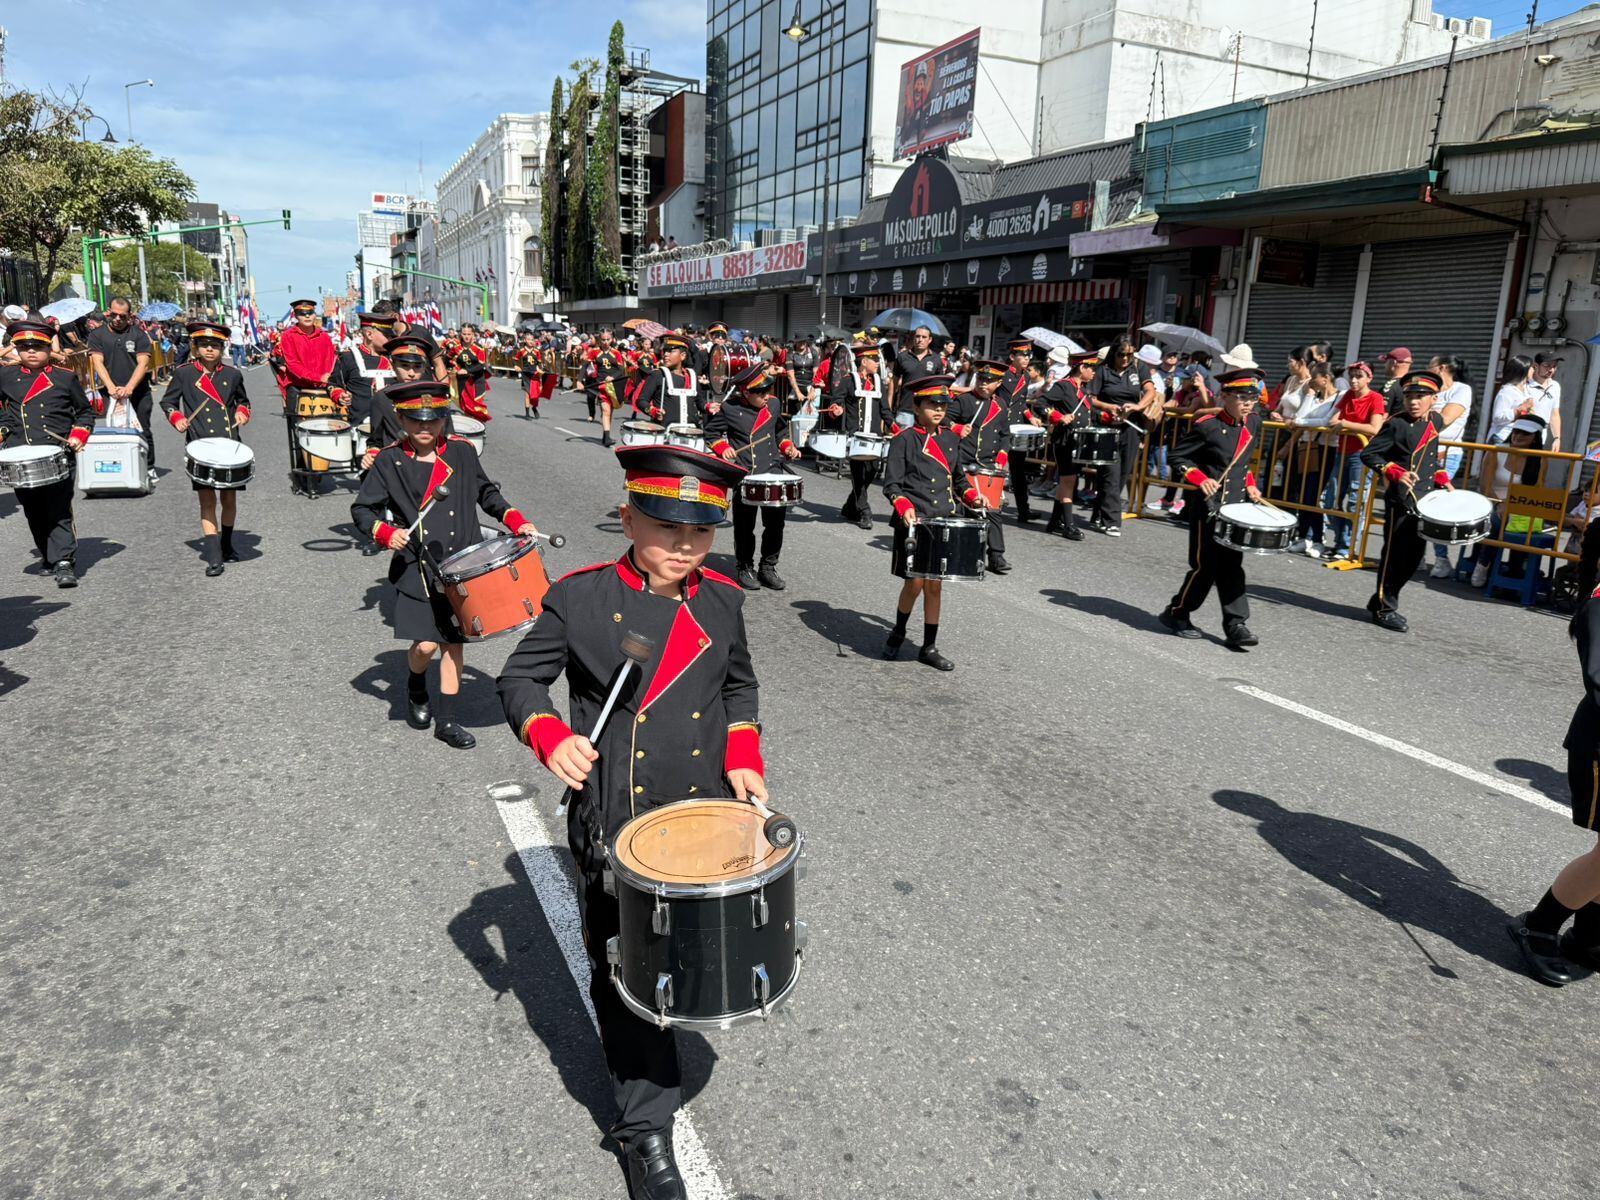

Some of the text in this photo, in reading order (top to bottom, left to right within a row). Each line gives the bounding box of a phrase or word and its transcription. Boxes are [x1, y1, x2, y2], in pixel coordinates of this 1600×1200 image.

[929, 85, 971, 117] TÍO PAPAS
[386, 194, 405, 205] BCR
[986, 213, 1033, 239] 4000 2626
[650, 266, 662, 286] SE
[665, 258, 713, 285] ALQUILA
